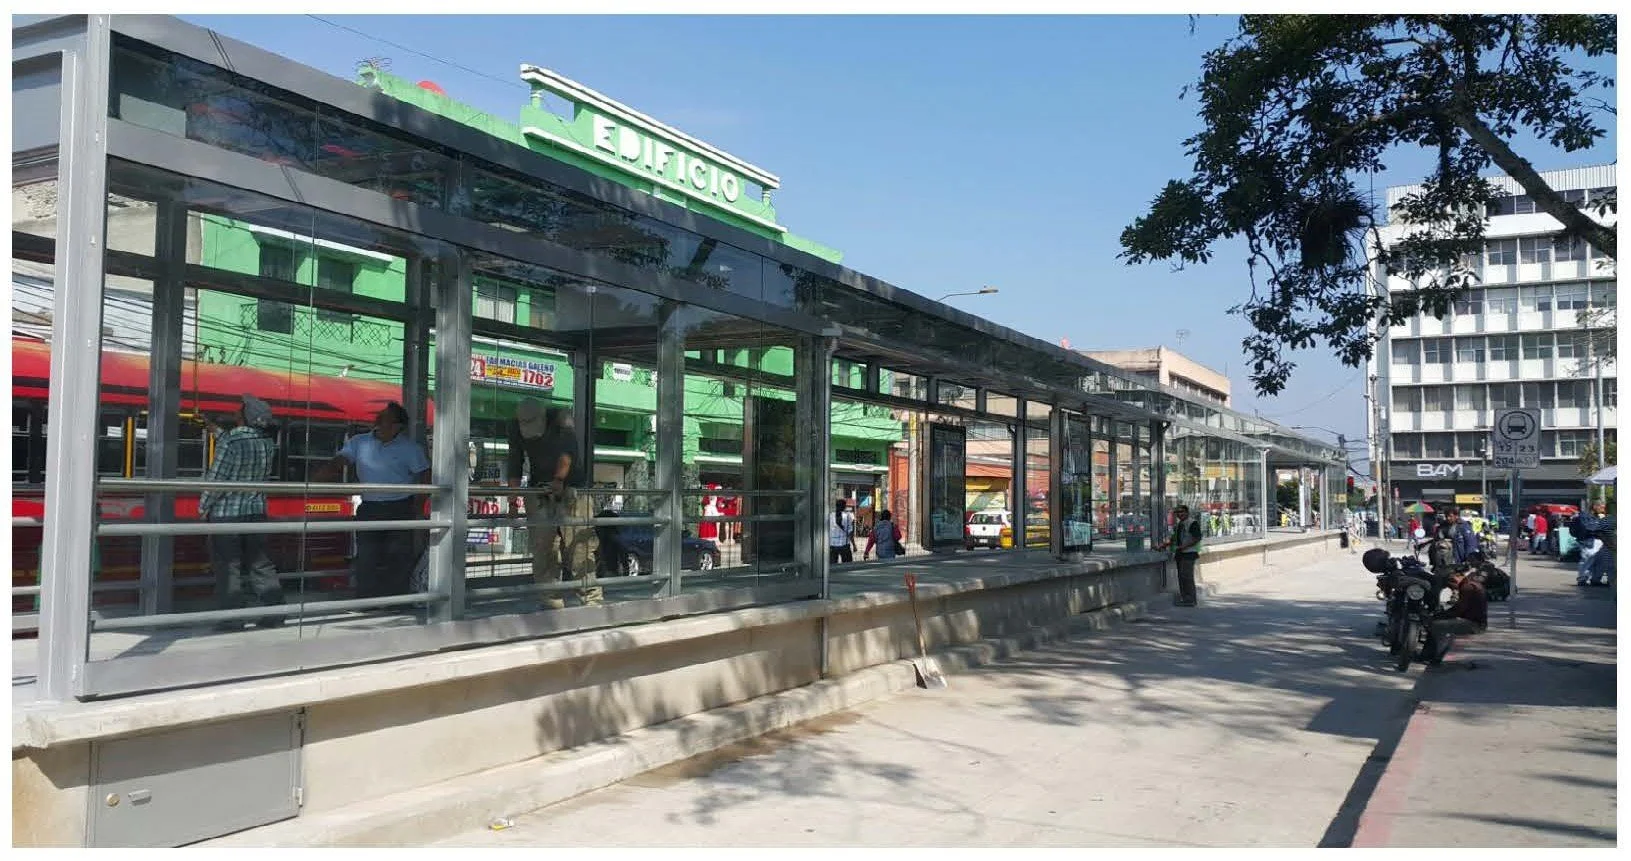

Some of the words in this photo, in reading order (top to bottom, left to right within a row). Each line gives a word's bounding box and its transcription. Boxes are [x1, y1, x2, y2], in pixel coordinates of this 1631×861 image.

[593, 114, 739, 202] EDIFICIO
[528, 361, 555, 373] GALENO
[522, 369, 553, 387] 1702
[1416, 463, 1464, 477] BAM
